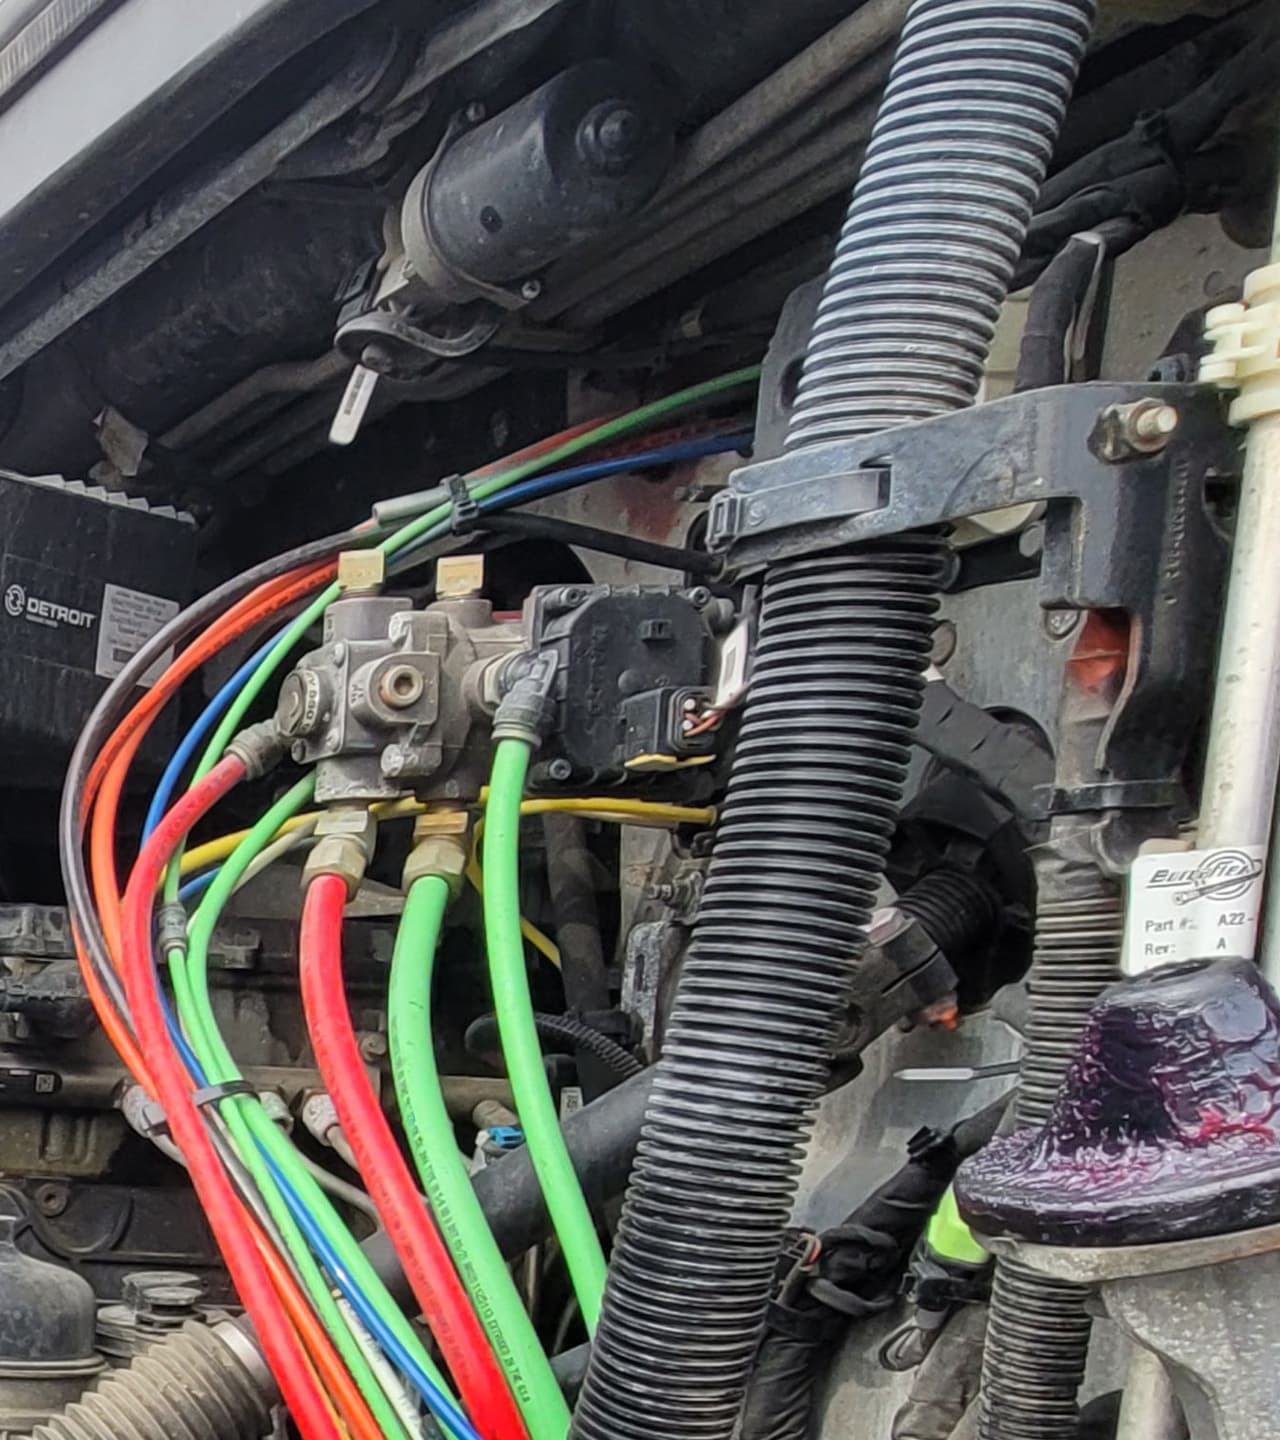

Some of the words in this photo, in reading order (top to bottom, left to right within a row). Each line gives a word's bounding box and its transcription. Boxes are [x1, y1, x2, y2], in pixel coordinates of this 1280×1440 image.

[26, 597, 97, 628] DETROIT
[1145, 919, 1174, 933] Part
[1144, 943, 1177, 956] Rev:
[1217, 937, 1226, 950] A
